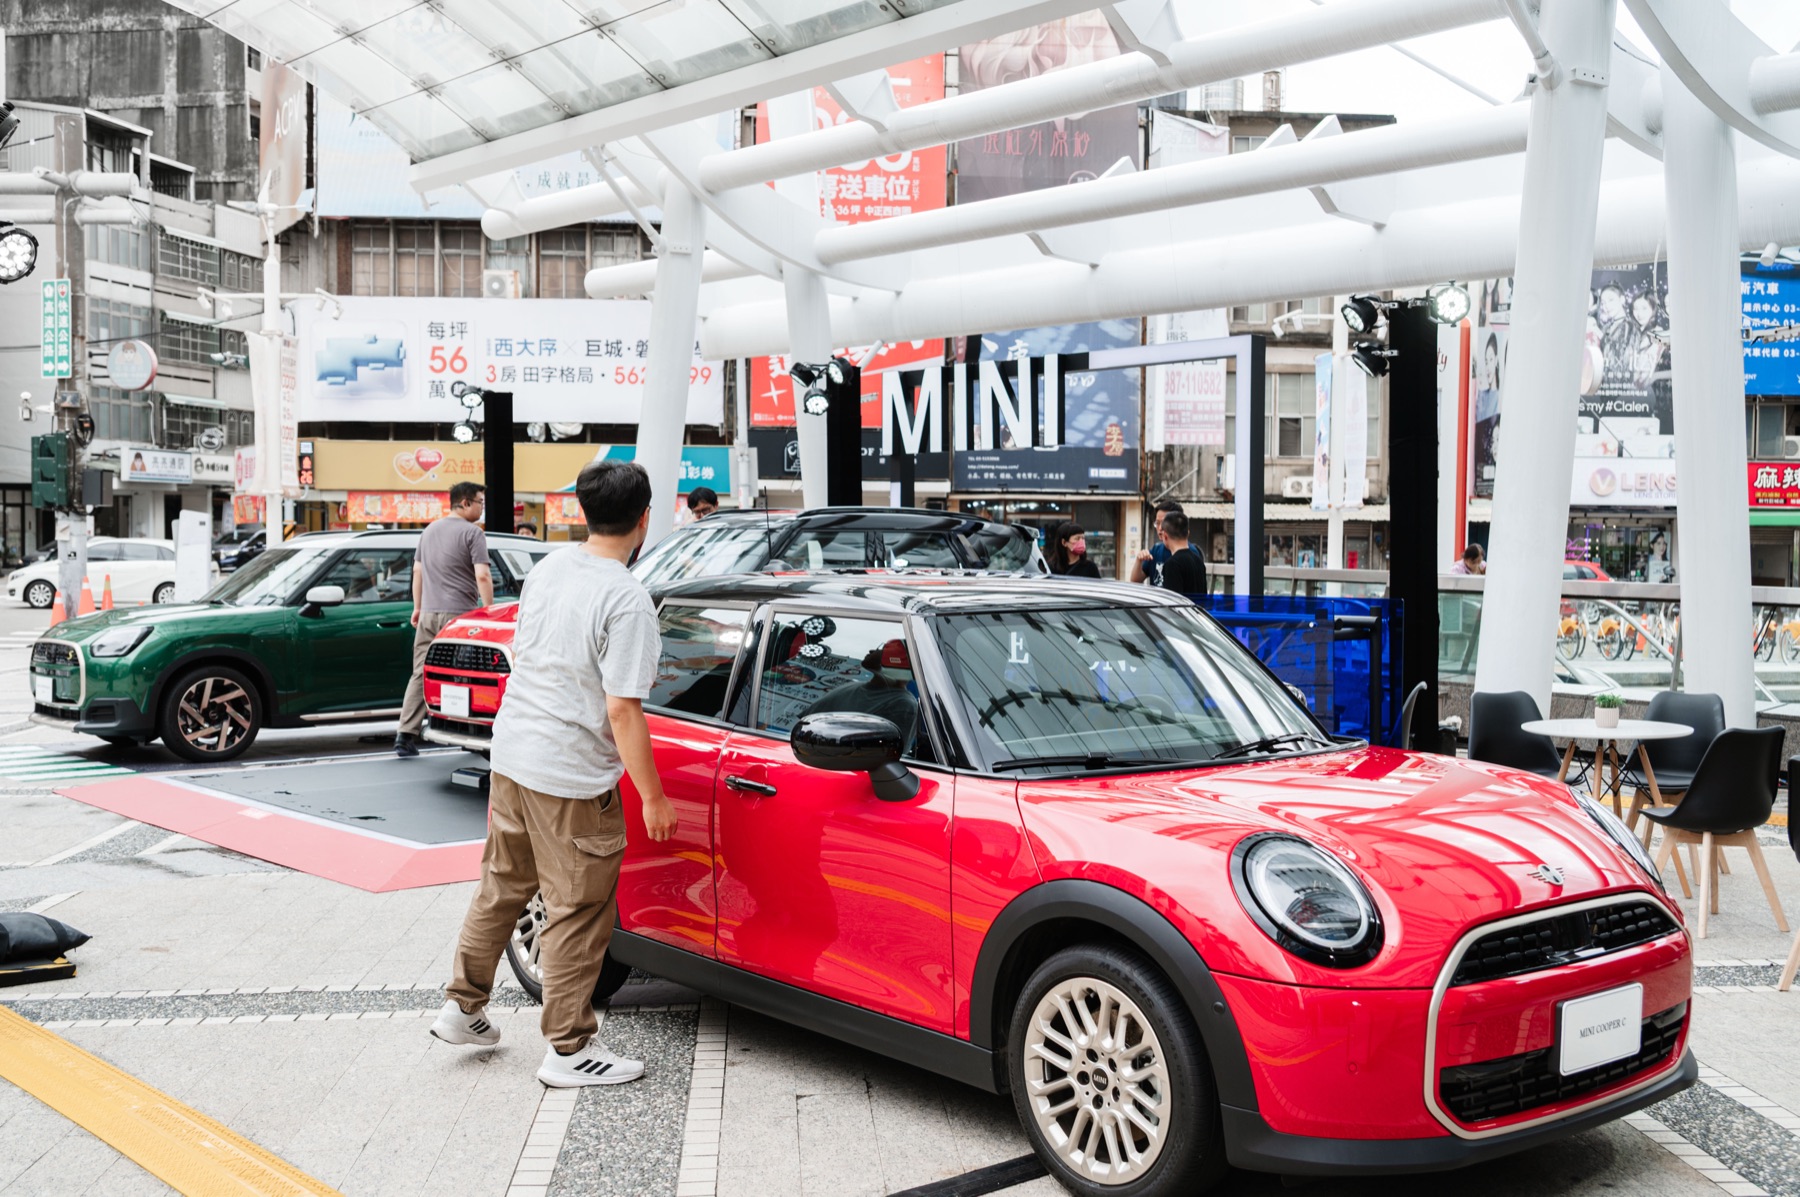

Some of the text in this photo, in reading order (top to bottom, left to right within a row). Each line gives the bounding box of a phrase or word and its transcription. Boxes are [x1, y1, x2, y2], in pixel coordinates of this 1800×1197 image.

[1743, 302, 1780, 314] 展示中心
[44, 300, 55, 357] 高速公路
[58, 299, 69, 357] 快速公路
[427, 322, 468, 340] 每坪
[494, 338, 557, 357] 西大序
[429, 346, 468, 374] 56
[882, 354, 1059, 455] MINI
[1621, 472, 1677, 493] LENS
[1655, 491, 1677, 499] STOR
[491, 653, 501, 666] S
[1579, 1017, 1627, 1039] MINI COOPER C
[1093, 1074, 1107, 1085] MINI
